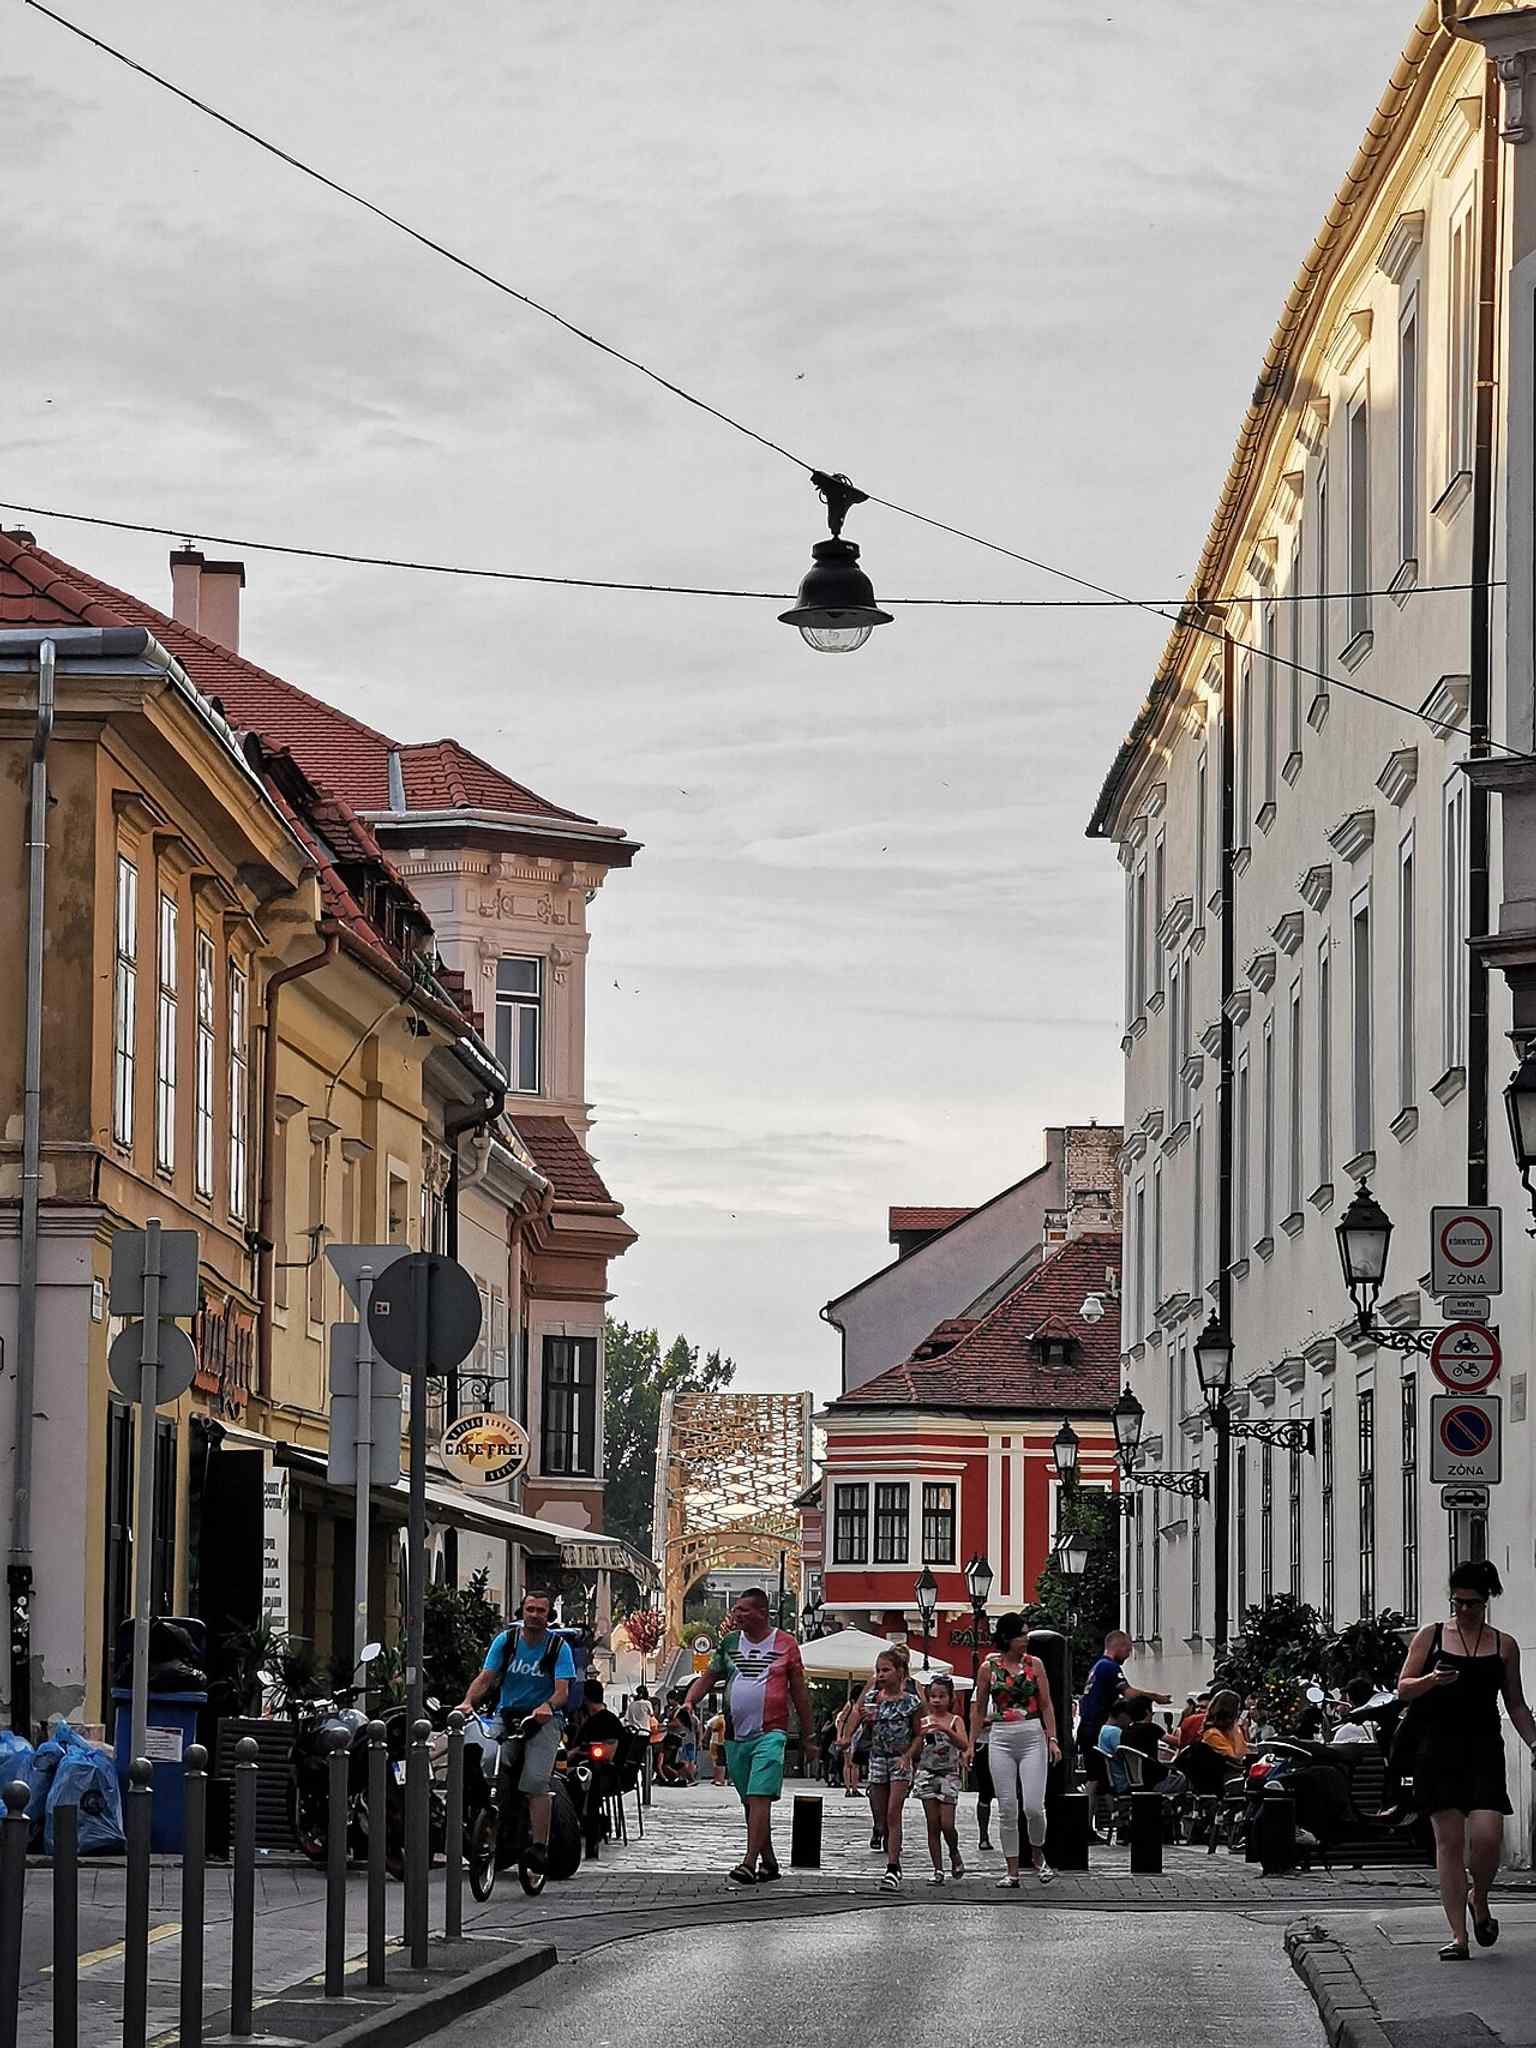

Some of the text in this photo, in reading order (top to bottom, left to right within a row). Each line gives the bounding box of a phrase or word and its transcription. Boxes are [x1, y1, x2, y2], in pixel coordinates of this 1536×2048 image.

[1447, 1272, 1486, 1285] ZÓNA
[445, 1443, 523, 1456] CAFE FREI
[1448, 1463, 1485, 1476] ZÓNA
